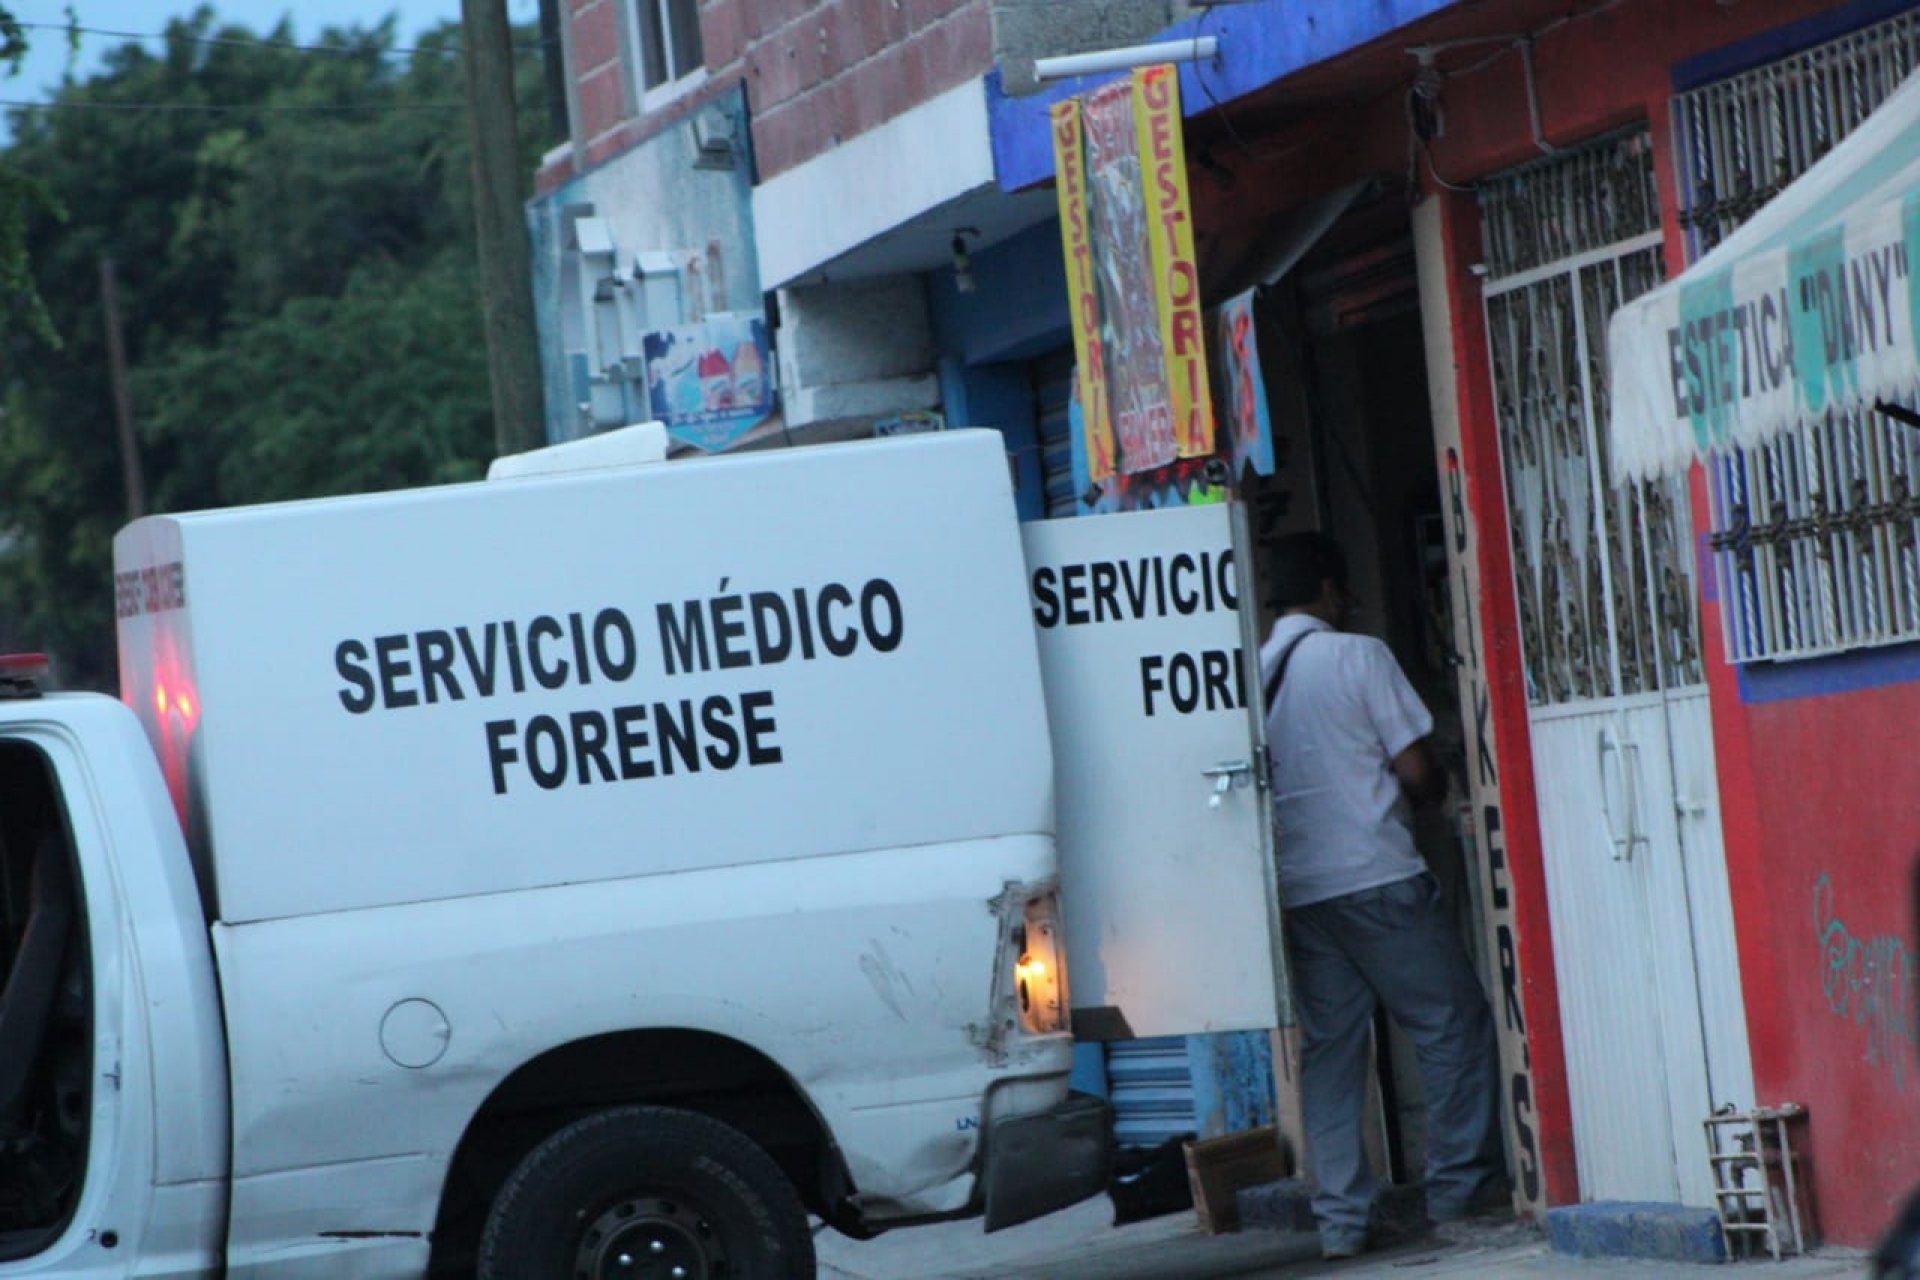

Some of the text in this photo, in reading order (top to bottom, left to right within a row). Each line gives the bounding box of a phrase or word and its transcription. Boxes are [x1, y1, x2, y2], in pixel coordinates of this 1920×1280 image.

[1142, 67, 1208, 453] GESTORIA
[1668, 286, 1797, 420] ESTETICA
[334, 577, 903, 714] SERVICIO MÉDICO
[485, 690, 782, 794] FORENSE
